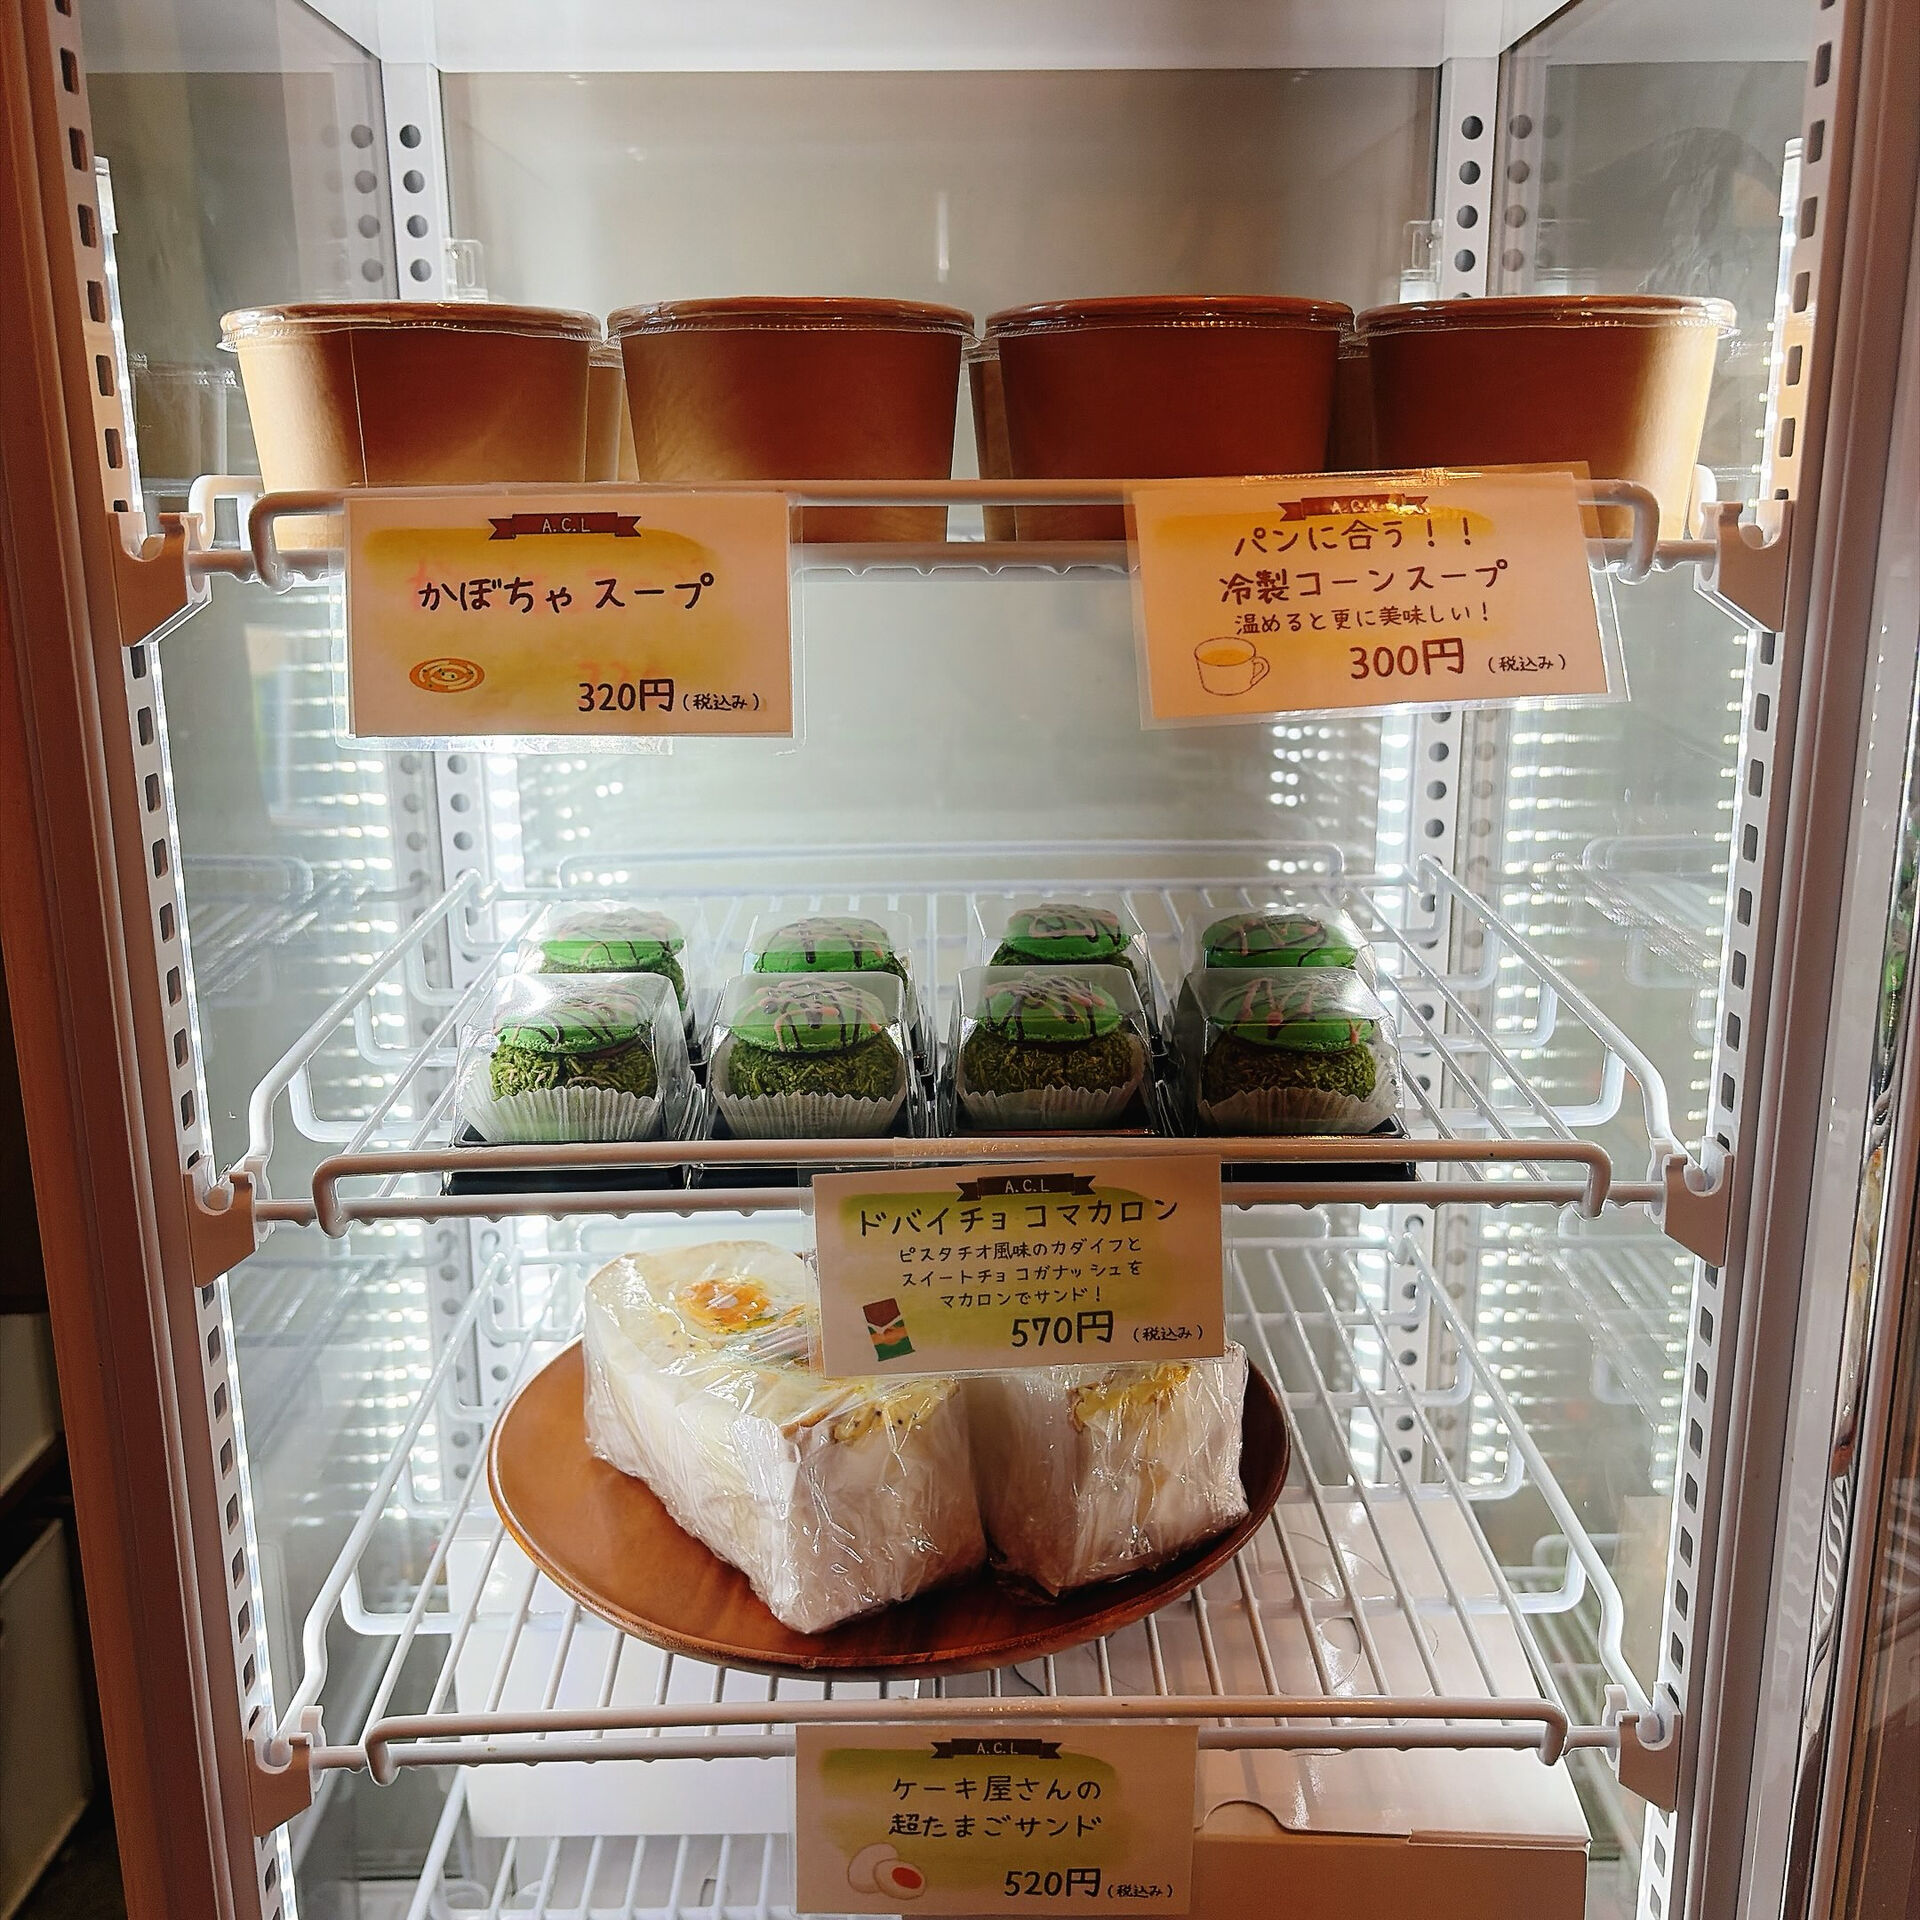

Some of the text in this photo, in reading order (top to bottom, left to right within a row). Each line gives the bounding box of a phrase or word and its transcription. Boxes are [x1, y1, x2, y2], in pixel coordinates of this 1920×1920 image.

[542, 517, 591, 532] A.C.L
[1234, 516, 1474, 556] パンに合う！！
[1218, 559, 1508, 604] 冷製コーンスープ
[1235, 602, 1488, 635] 温めると更に美味しい！
[1350, 637, 1464, 680] 300円
[578, 679, 674, 712] 320円
[1005, 1179, 1050, 1193] A.C.L
[860, 1199, 1178, 1236] ドバイチョコマカロン
[900, 1237, 1142, 1263] ピスタチオ風味のカダイフと
[902, 1259, 1142, 1287] スイートチョコガナッシュを
[940, 1286, 1102, 1308] マカロンでサンド！
[1011, 1310, 1113, 1348] 570円
[976, 1742, 1019, 1755] A.C.L
[892, 1775, 1101, 1802] ケーキ屋さんの
[888, 1813, 1102, 1838] 超たまごサンド
[1004, 1868, 1100, 1898] 520円
